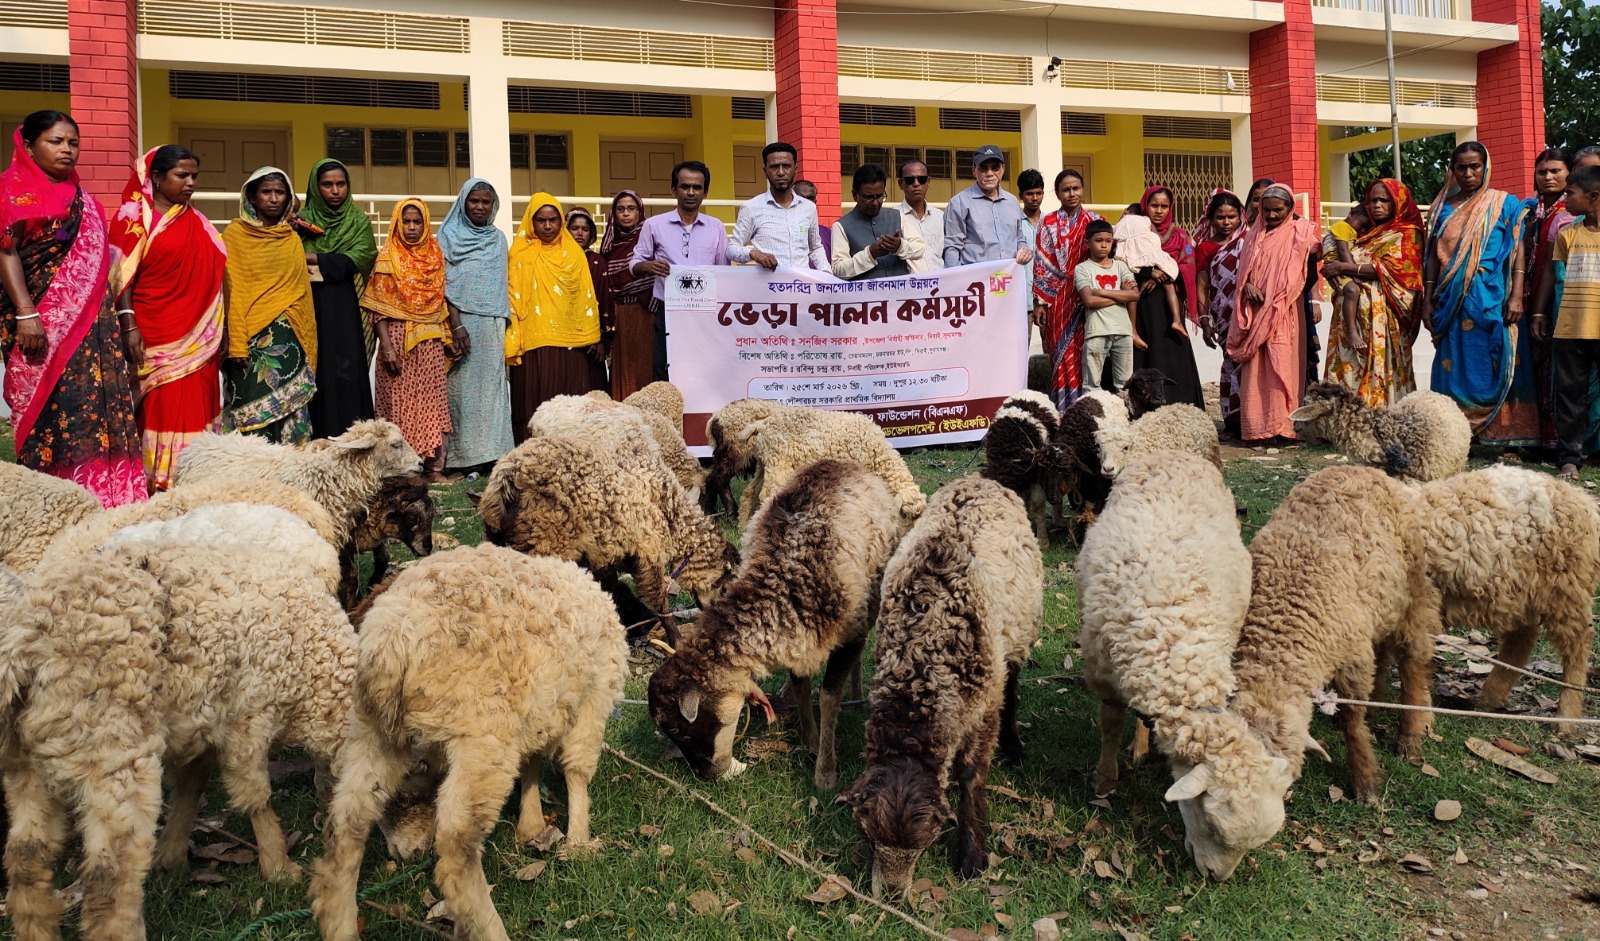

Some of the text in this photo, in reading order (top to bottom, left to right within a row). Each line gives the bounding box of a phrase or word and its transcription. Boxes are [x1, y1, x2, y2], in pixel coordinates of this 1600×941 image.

[768, 279, 812, 294] হতদরিদ্র
[909, 277, 939, 290] উন্নয়নে
[717, 281, 985, 329] ভেড়া পালন কর্মসূচী
[735, 336, 757, 347] প্রধান
[760, 335, 789, 346] অতিথি
[830, 336, 858, 346] সরকার
[739, 350, 762, 361] বিশেষ
[764, 350, 788, 360] অতিথি
[797, 350, 829, 361] পরিতোষ
[761, 363, 788, 373] সভাপতি
[816, 365, 828, 374] চন্দ্র
[763, 382, 784, 391] তারিখ
[791, 384, 811, 392] ২৫শে
[813, 381, 825, 390] মার্চ
[827, 383, 848, 391] ২০২৬
[873, 380, 887, 389] সময়
[893, 379, 907, 388] দুপুর
[909, 378, 928, 386] ১২.৩০
[930, 374, 947, 383] ঘটিকা
[818, 395, 843, 404] সরকারি
[845, 394, 869, 403] প্রাথমিক
[877, 408, 921, 422] ফাউন্ডেশন
[923, 403, 968, 421] (বিএনএফ)
[938, 415, 991, 434] (ইউইএফডি)
